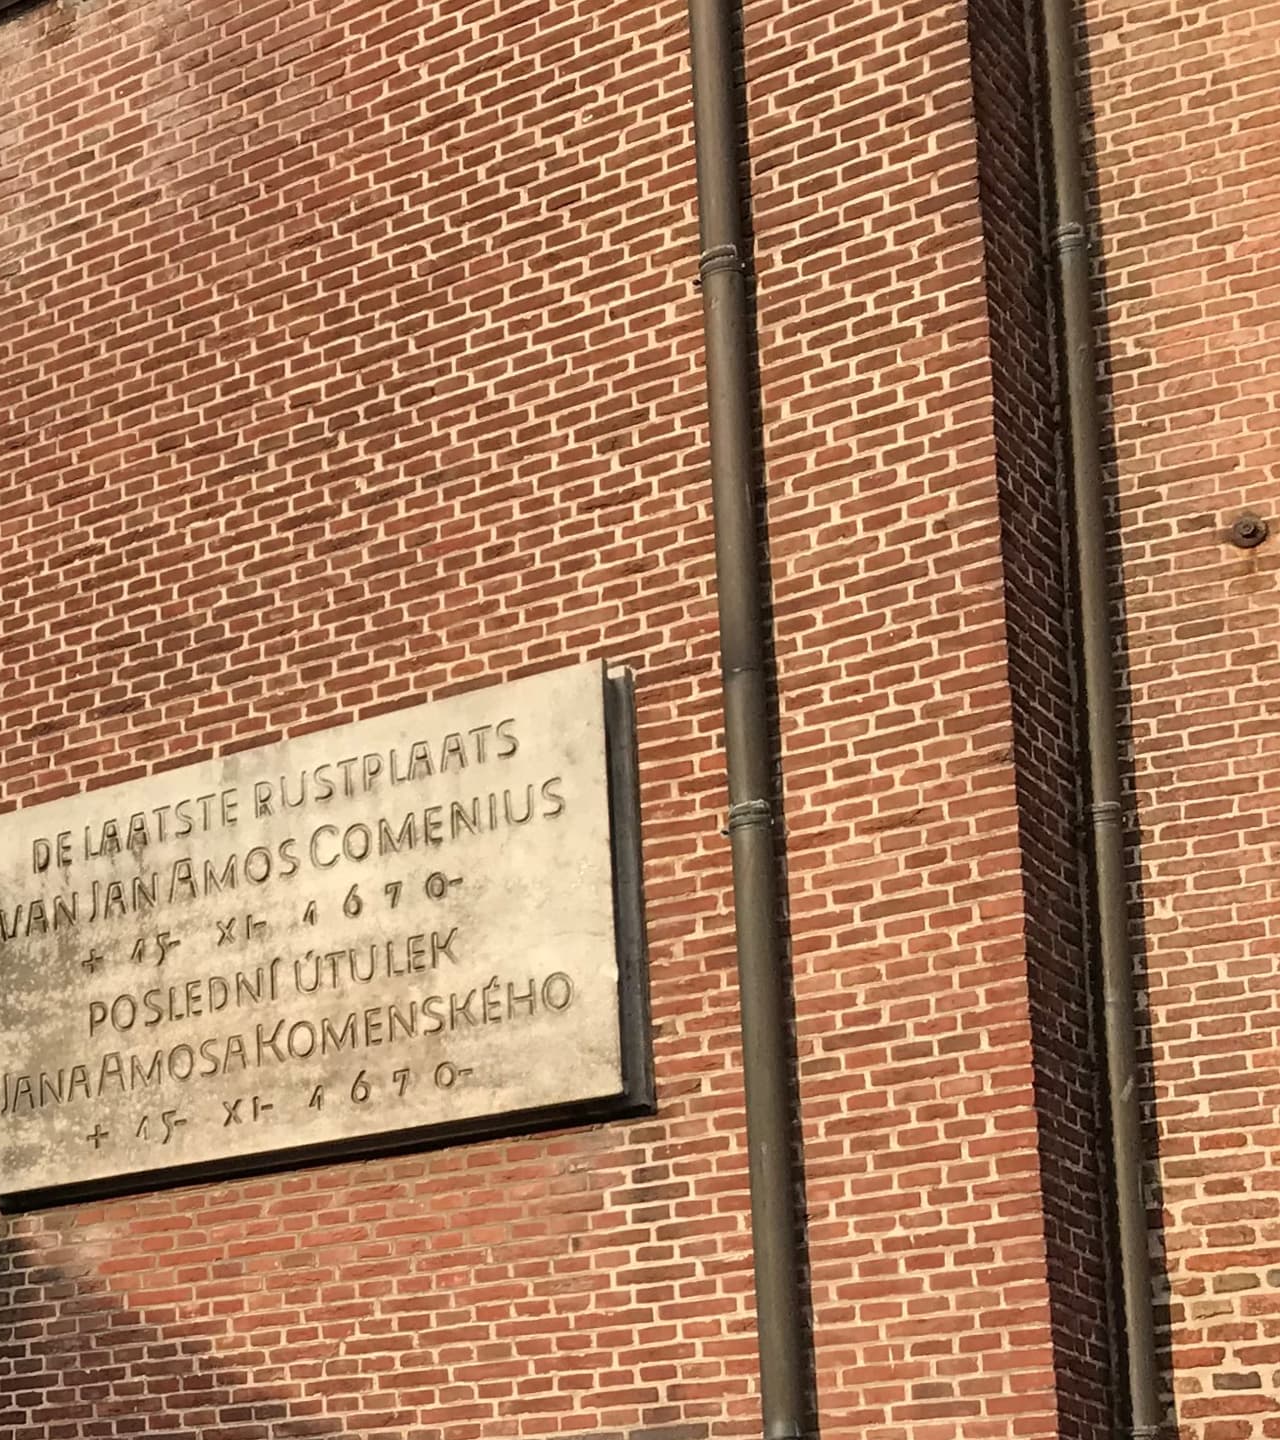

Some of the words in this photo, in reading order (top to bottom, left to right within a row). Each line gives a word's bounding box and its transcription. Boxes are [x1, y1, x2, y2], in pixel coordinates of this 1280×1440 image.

[32, 830, 73, 874] DE
[83, 787, 239, 860] LAATSTE
[253, 717, 521, 818] RUSTPLAATS
[89, 872, 159, 923] JAN
[168, 837, 301, 904] AMOS
[309, 776, 567, 870] COMENIUS
[0, 1064, 91, 1116] JANA
[97, 1033, 248, 1097] AMOSA
[255, 971, 575, 1068] KOMENSKÉHO
[89, 956, 281, 1037] POSLEDNÍ
[293, 926, 459, 994] ÚTULEK
